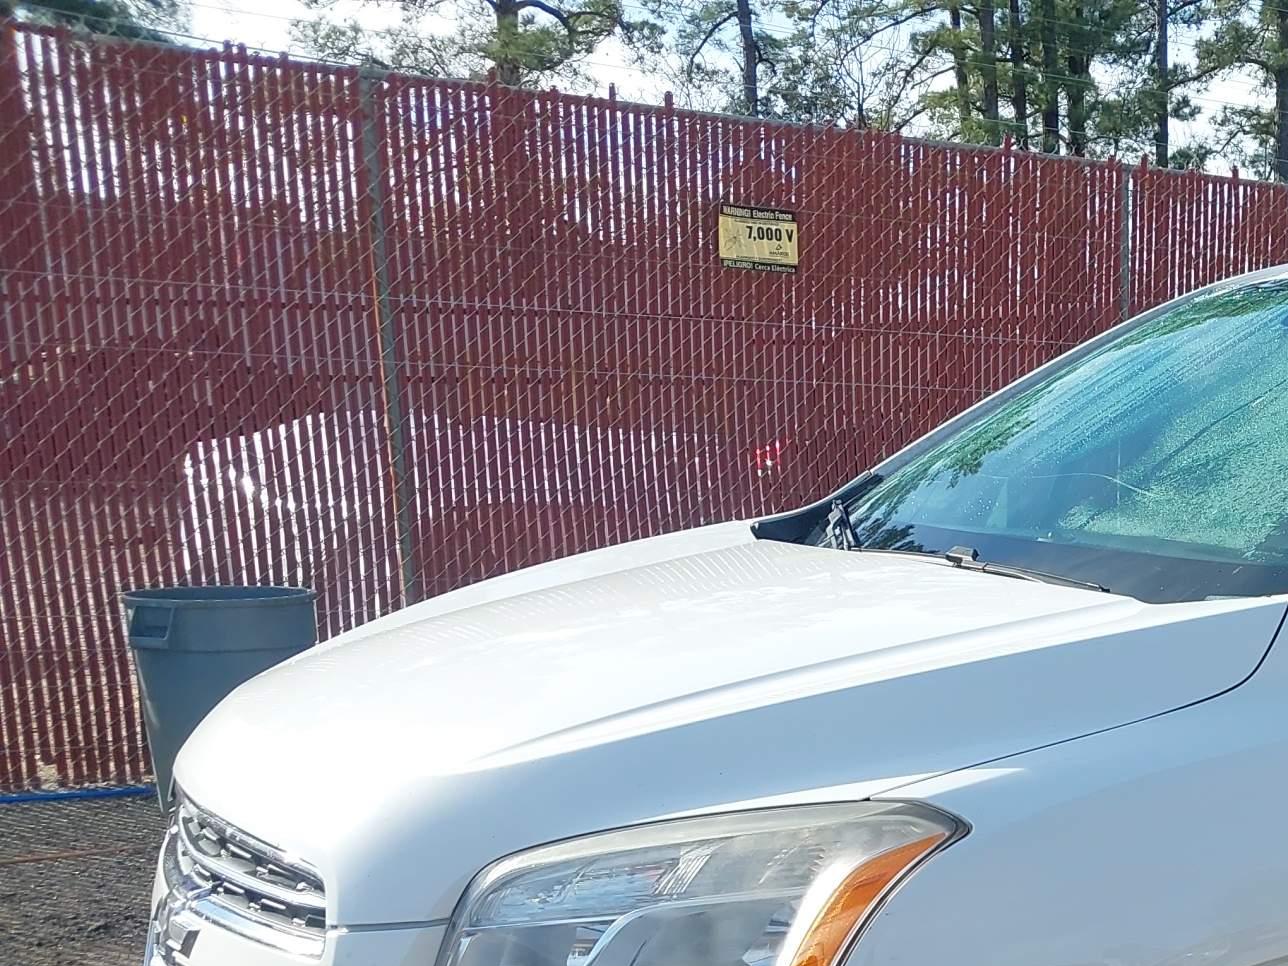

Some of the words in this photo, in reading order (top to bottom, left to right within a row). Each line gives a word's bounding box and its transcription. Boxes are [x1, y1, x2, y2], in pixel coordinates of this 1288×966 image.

[753, 209, 775, 219] Electric
[775, 212, 793, 221] Fence
[746, 225, 782, 241] 7,000
[785, 229, 794, 243] V
